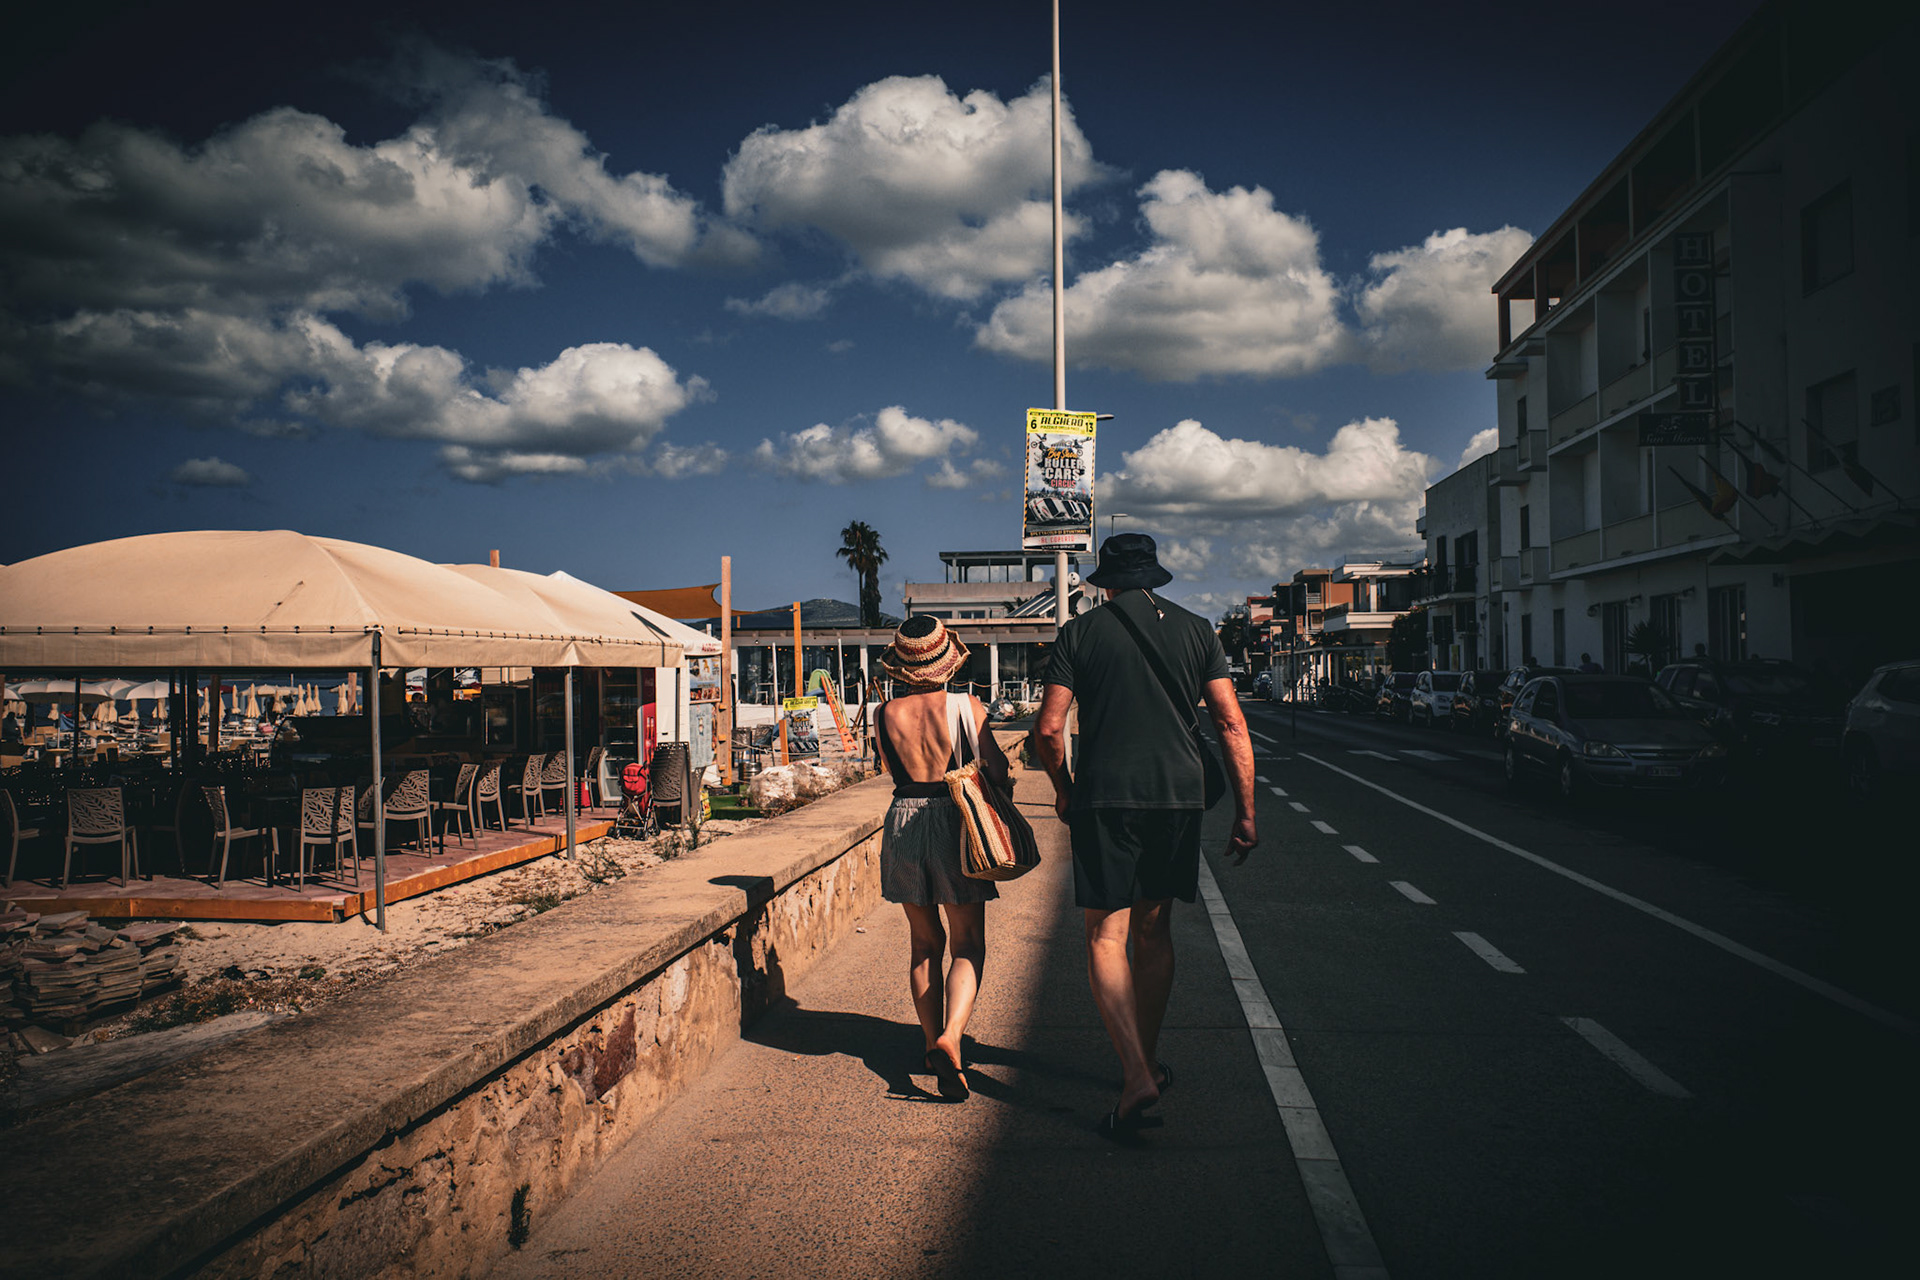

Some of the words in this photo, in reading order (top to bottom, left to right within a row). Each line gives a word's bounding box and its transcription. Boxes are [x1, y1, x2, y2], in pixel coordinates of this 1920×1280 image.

[1677, 236, 1708, 405] HOTEL
[1030, 419, 1037, 429] 6
[1040, 416, 1084, 427] ALGHERO
[1085, 422, 1094, 433] 13
[1046, 447, 1061, 460] Big
[1045, 467, 1080, 481] CARS
[1050, 479, 1076, 489] CIRCUS
[1050, 535, 1075, 543] COPERTO
